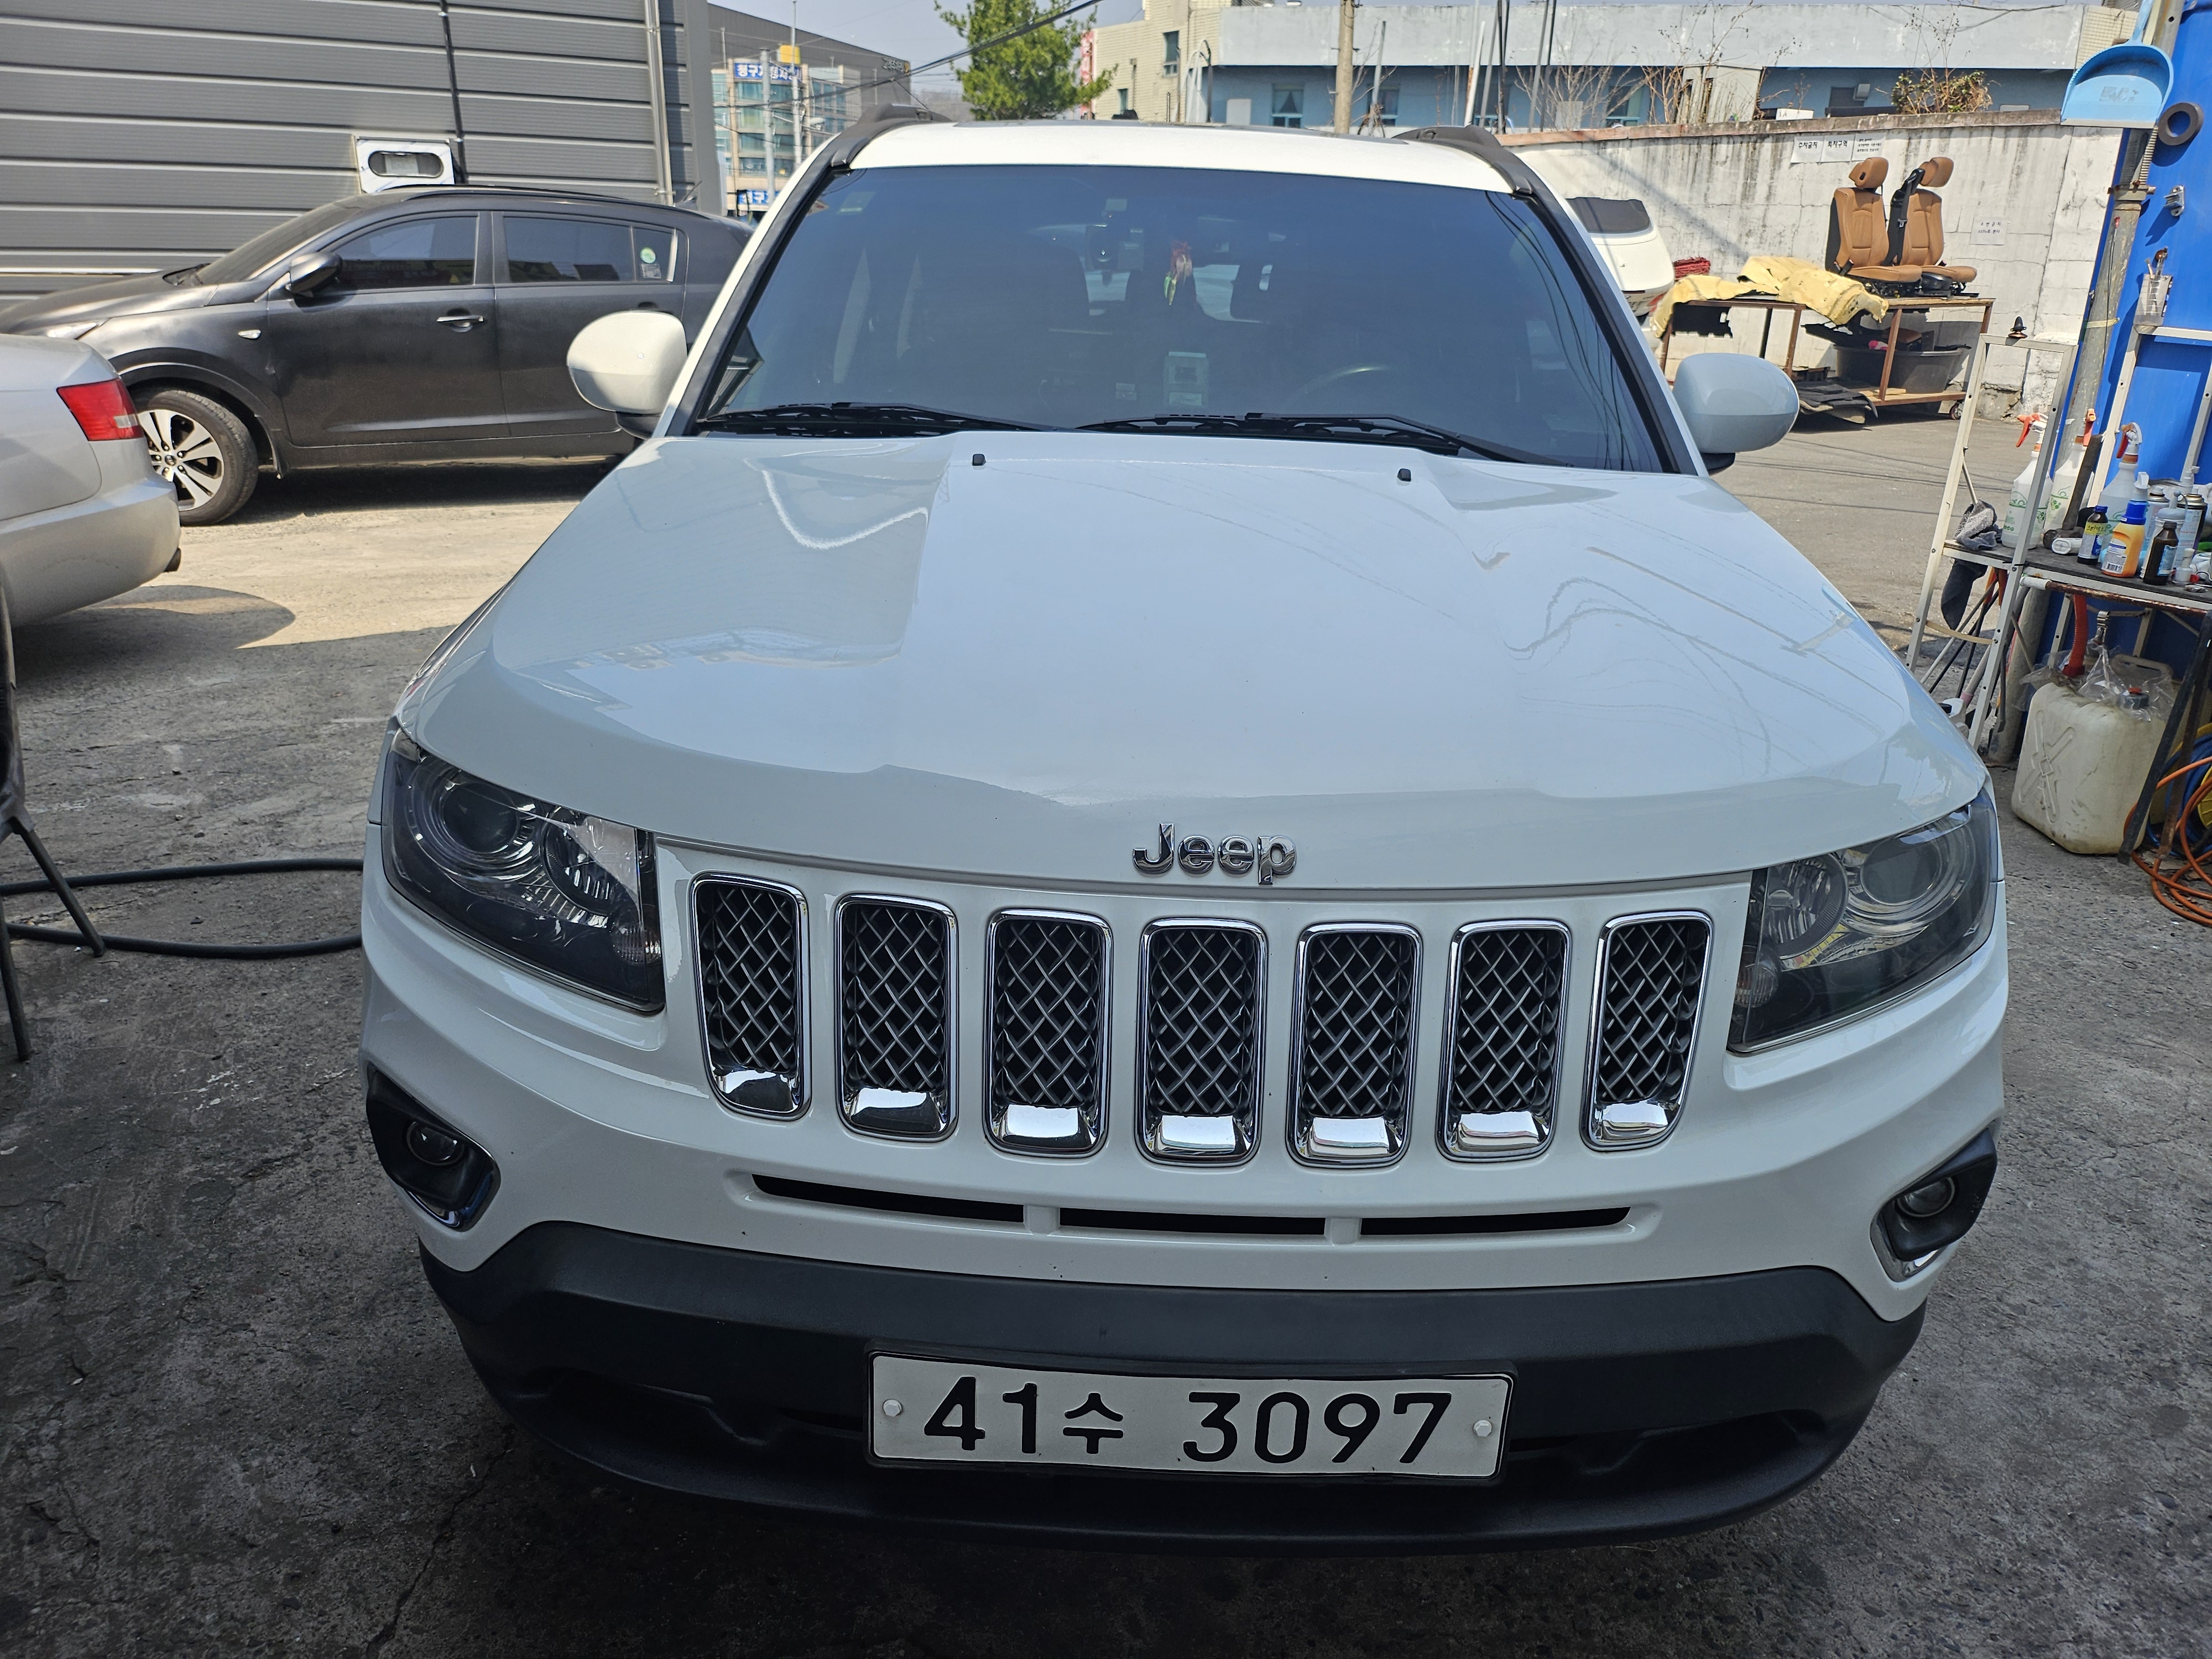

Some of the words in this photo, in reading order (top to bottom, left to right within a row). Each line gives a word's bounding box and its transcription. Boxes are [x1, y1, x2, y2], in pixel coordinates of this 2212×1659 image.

[1133, 823, 1297, 885] Jeep
[924, 1375, 1124, 1454] 41수
[1183, 1391, 1453, 1464] 3097
